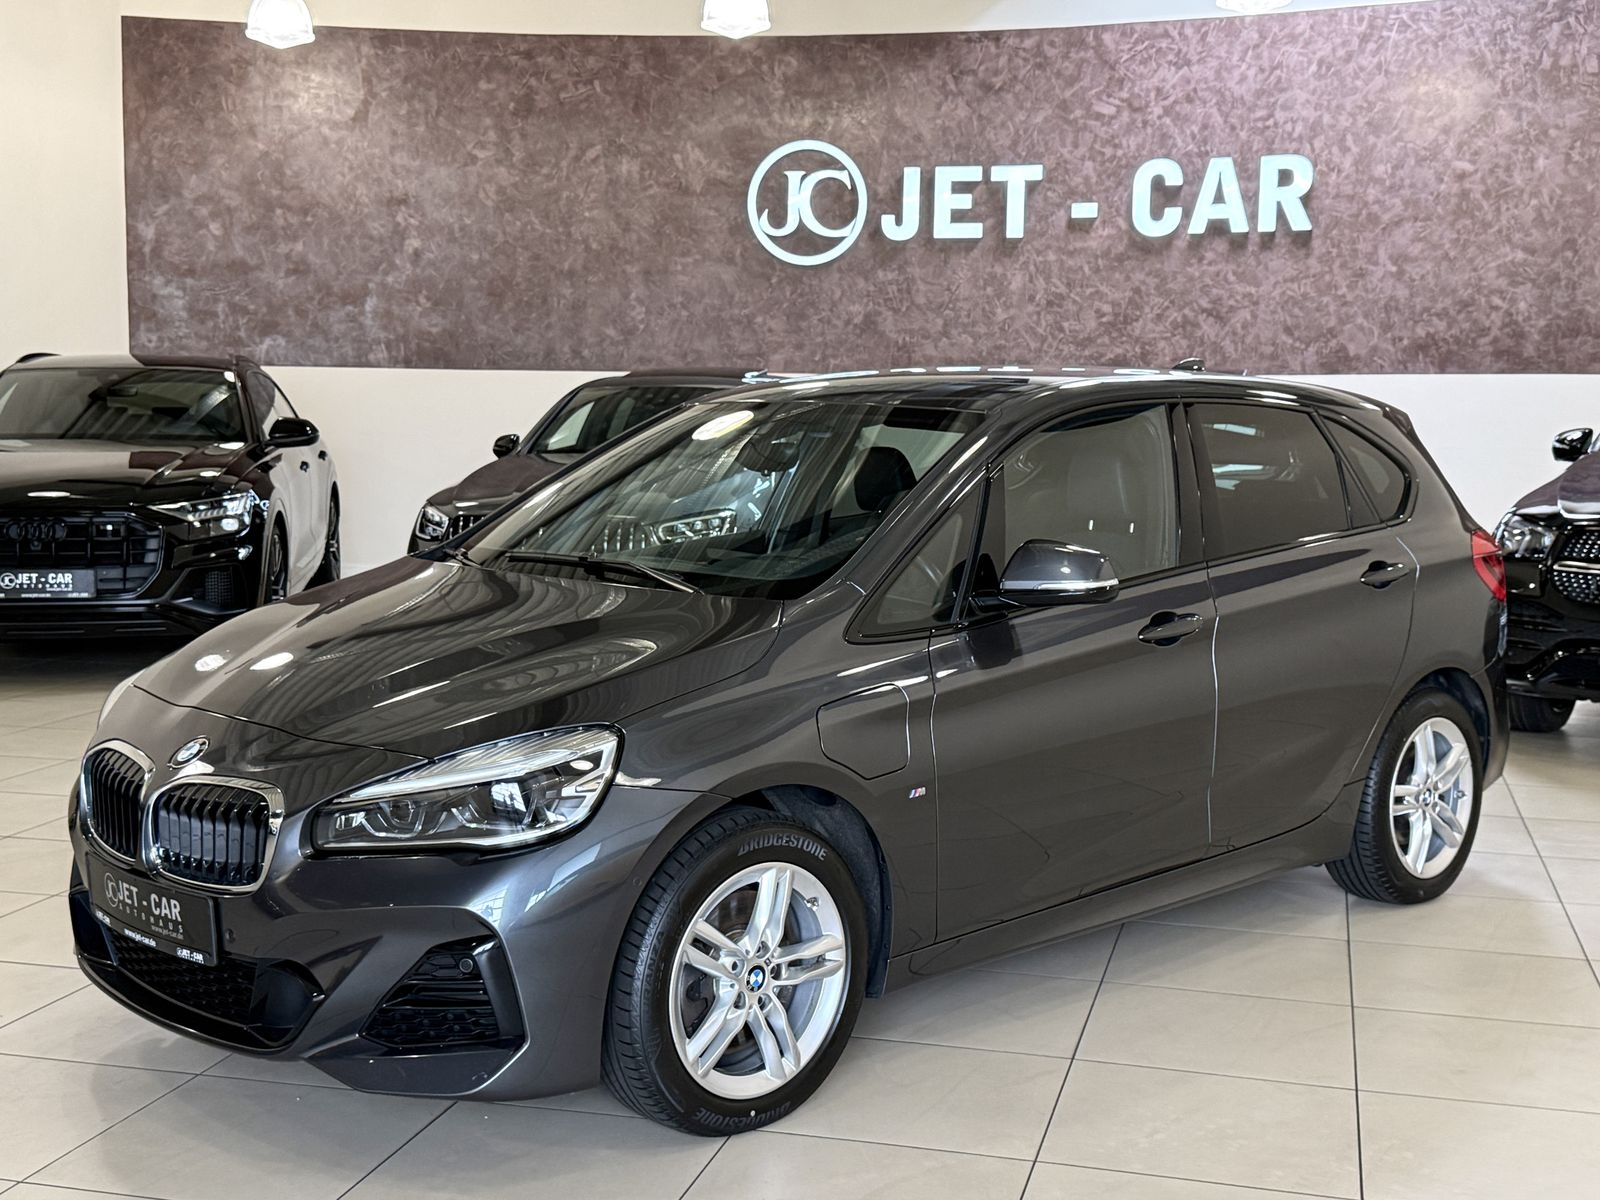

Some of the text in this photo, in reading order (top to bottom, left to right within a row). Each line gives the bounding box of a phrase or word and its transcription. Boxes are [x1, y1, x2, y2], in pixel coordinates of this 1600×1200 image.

[880, 153, 1316, 242] JET - CAR
[16, 573, 38, 584] JET
[48, 573, 73, 584] CAR
[737, 832, 829, 861] BRIDGESTONE
[117, 880, 139, 907] JET
[150, 893, 182, 922] CAR
